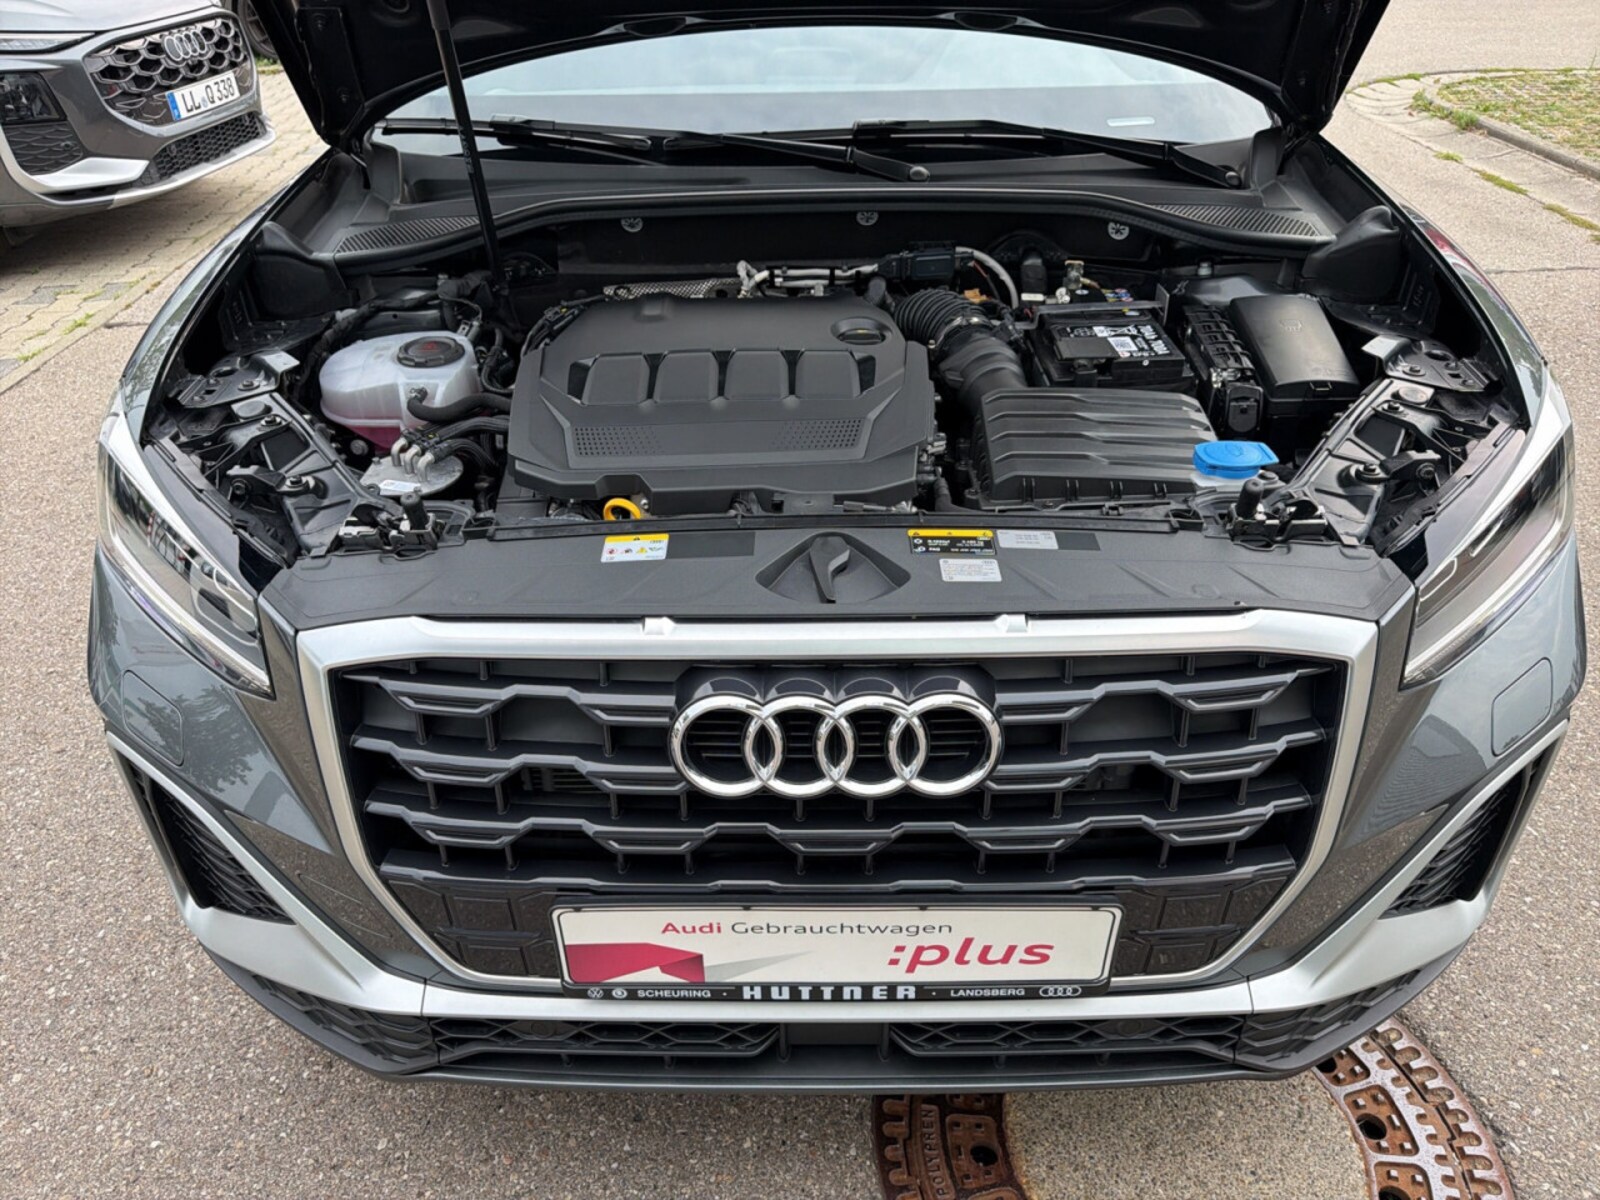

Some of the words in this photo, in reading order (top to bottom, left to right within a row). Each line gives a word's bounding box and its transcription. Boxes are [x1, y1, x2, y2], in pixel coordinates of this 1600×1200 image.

[181, 90, 202, 113] LL
[205, 84, 216, 104] Q
[213, 76, 235, 102] 338
[661, 922, 722, 935] Audi
[730, 922, 953, 937] Gebrauchtwagen
[887, 937, 1055, 974] :plus
[637, 989, 711, 999] SCHEURING
[950, 988, 1026, 998] LANDSBERG
